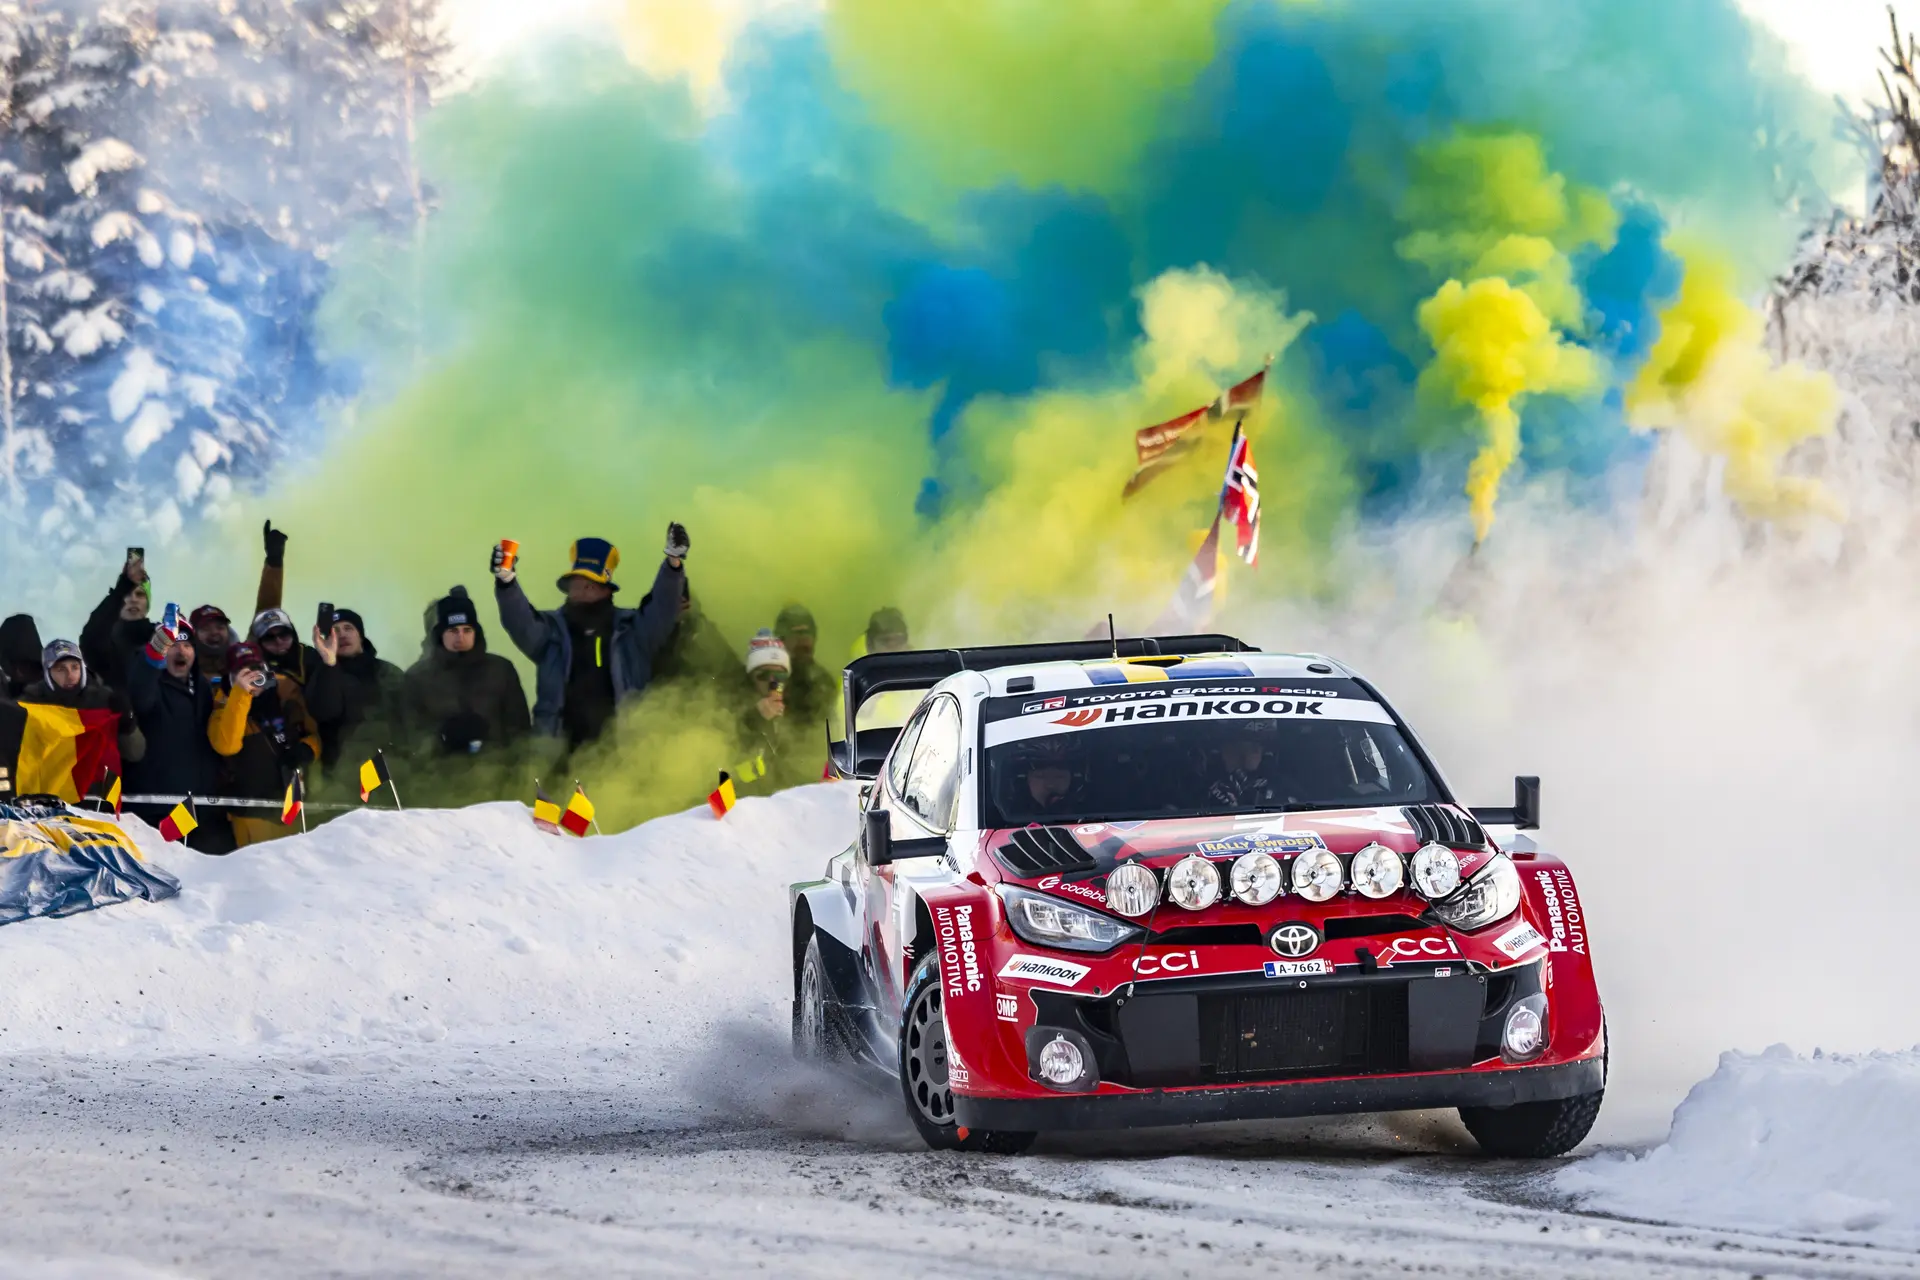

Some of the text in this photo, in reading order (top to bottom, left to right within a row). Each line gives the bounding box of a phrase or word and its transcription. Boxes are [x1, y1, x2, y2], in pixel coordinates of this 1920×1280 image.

[1073, 686, 1338, 704] TOYOTA GAZOO Racing
[1023, 698, 1065, 714] GR
[1205, 841, 1249, 852] RALLY
[1255, 837, 1316, 848] SWEDEN
[1060, 882, 1106, 903] codebe
[1534, 870, 1568, 952] Panasonic
[1552, 869, 1585, 955] AUTOMOTIVE
[936, 907, 963, 997] AUTOMOTIVE
[954, 905, 984, 992] Panasonic
[1279, 962, 1322, 974] A-7662
[996, 998, 1018, 1017] OMP
